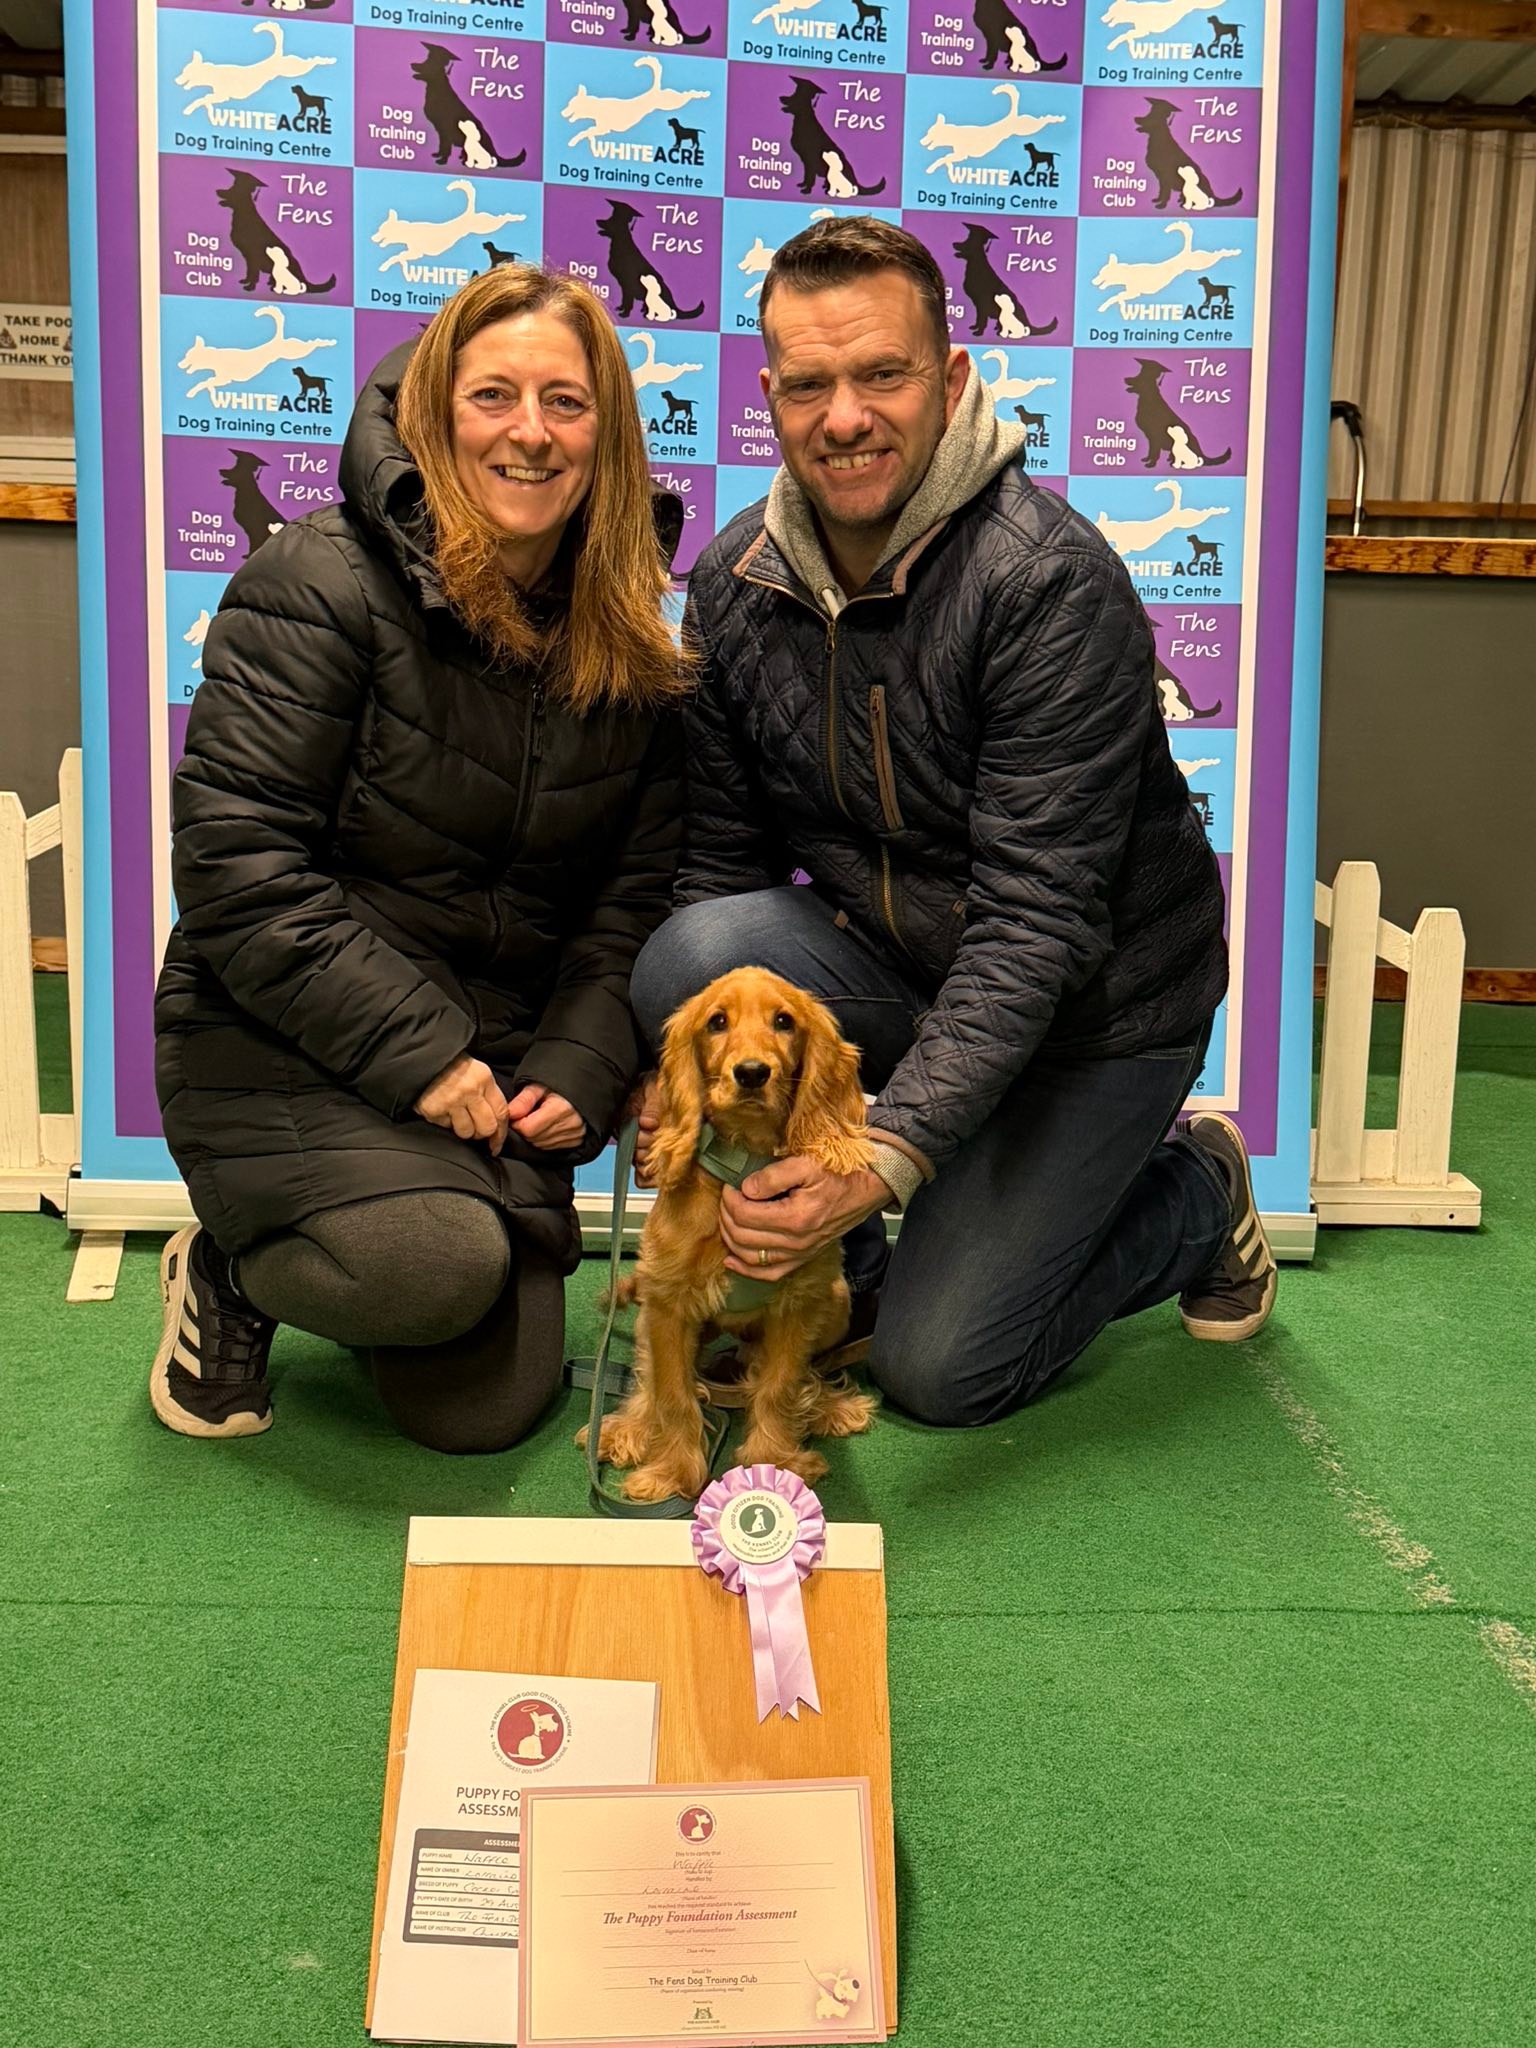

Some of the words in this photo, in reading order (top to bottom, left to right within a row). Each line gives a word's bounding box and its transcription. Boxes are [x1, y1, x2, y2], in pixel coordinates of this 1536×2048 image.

[371, 6, 402, 24] Dog
[407, 8, 467, 30] Training
[472, 14, 524, 32] Centre
[560, 0, 615, 20] Training
[571, 19, 605, 35] Club
[775, 17, 888, 42] WHITEACRE
[934, 14, 962, 32] Dog
[920, 32, 974, 50] Training
[474, 47, 520, 70] The
[743, 41, 773, 58] Dog
[777, 44, 832, 64] Training
[838, 49, 886, 64] Centre
[930, 51, 964, 66] Club
[1129, 41, 1244, 60] WHITEACRE
[1098, 66, 1128, 82] Dog
[1132, 66, 1188, 83] Training
[1193, 67, 1243, 80] Centre
[470, 76, 524, 100] Fens
[838, 80, 881, 102] The
[382, 105, 412, 124] Dog
[1194, 96, 1238, 116] The
[207, 108, 331, 134] WHITEACRE
[834, 109, 886, 131] Fens
[368, 124, 426, 144] Training
[1189, 125, 1242, 144] Fens
[174, 132, 207, 152] Dog
[211, 135, 274, 156] Training
[279, 141, 331, 158] Centre
[379, 145, 415, 161] Club
[590, 141, 704, 166] WHITEACRE
[751, 137, 780, 155] Dog
[738, 155, 792, 174] Training
[1106, 158, 1135, 174] Dog
[280, 174, 328, 196] The
[559, 164, 589, 182] Dog
[593, 167, 650, 186] Training
[654, 172, 704, 190] Centre
[748, 175, 781, 190] Club
[948, 165, 1060, 188] WHITEACRE
[1093, 175, 1147, 192] Training
[918, 190, 946, 206] Dog
[951, 191, 1006, 210] Training
[1010, 194, 1058, 210] Centre
[1103, 193, 1136, 208] Club
[277, 203, 333, 226] Fens
[656, 203, 699, 226] The
[187, 233, 219, 251] Dog
[651, 233, 703, 254] Fens
[1011, 225, 1054, 246] The
[174, 251, 233, 271] Training
[569, 261, 597, 278] Dog
[1005, 252, 1058, 272] Fens
[186, 271, 222, 286] Club
[371, 289, 401, 306] Dog
[4, 315, 40, 326] TAKE
[1119, 303, 1234, 320] WHITEACRE
[20, 335, 59, 346] HOME
[1089, 328, 1118, 342] Dog
[1123, 328, 1179, 344] Training
[1184, 328, 1233, 342] Centre
[0, 353, 47, 364] THANK
[52, 355, 73, 366] YO
[1184, 356, 1227, 378] The
[212, 391, 333, 414] WHITEACRE
[1179, 385, 1231, 404] Fens
[744, 407, 772, 424] Dog
[178, 414, 210, 432] Dog
[215, 417, 274, 436] Training
[280, 420, 332, 436] Centre
[731, 424, 778, 442] Trainin
[1096, 418, 1125, 434] Dog
[648, 442, 696, 456] Centre
[741, 443, 774, 456] Club
[1083, 436, 1136, 451] Training
[282, 451, 329, 474] The
[1093, 452, 1126, 466] Club
[650, 472, 692, 492] The
[279, 481, 334, 502] Fens
[191, 511, 222, 527] Dog
[178, 529, 236, 546] Training
[189, 548, 225, 562] Club
[1173, 584, 1222, 597] Centre
[1174, 612, 1218, 632] The
[1170, 640, 1221, 658] Fens
[456, 1787, 500, 1800] PUPPY
[458, 1803, 520, 1817] ASSESSM
[484, 1839, 520, 1848] ASSESSME
[603, 1912, 623, 1925] The
[626, 1912, 663, 1927] Puppy
[666, 1909, 732, 1923] Foundation
[735, 1909, 797, 1921] Assessment
[649, 1977, 664, 1986] The
[666, 1976, 685, 1985] Fens
[687, 1976, 703, 1986] Dog
[705, 1976, 738, 1986] Training
[740, 1975, 758, 1983] Club
